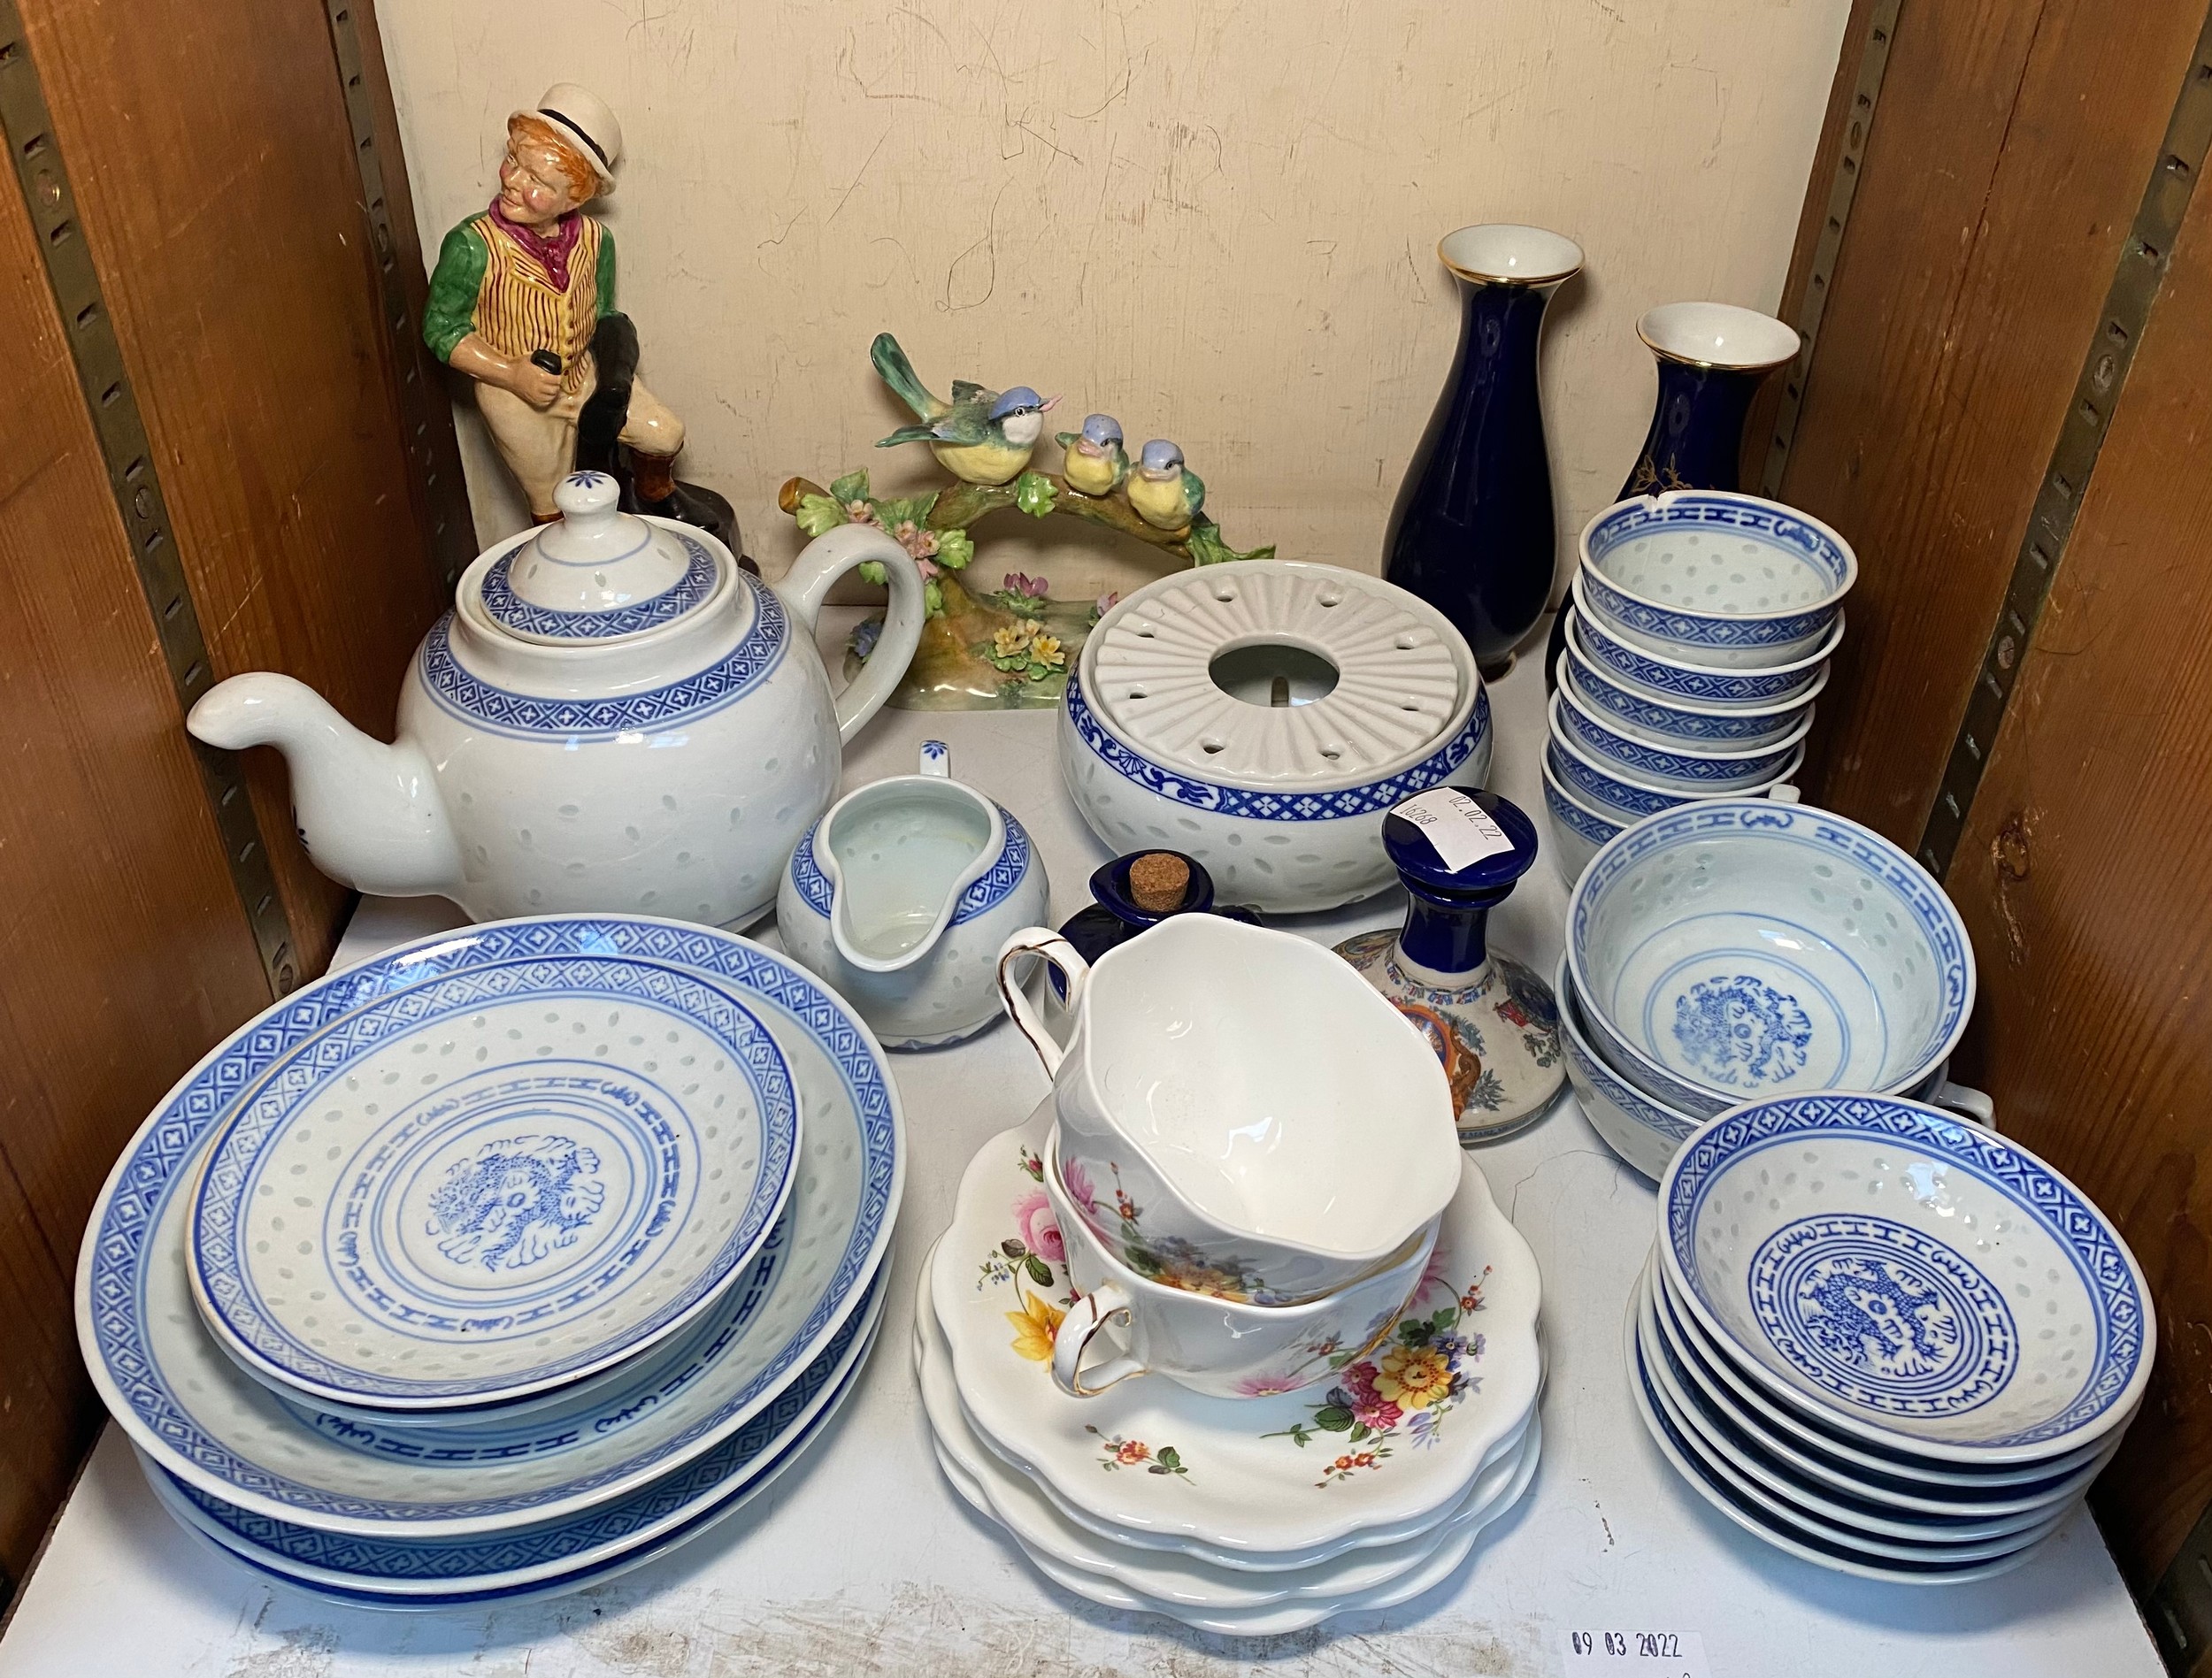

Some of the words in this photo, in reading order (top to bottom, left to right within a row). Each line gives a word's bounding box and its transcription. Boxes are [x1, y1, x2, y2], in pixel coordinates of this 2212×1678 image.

[1448, 795, 1502, 840] 02.02.22
[1571, 1631, 1593, 1656] 09
[1604, 1631, 1627, 1656] 03
[1635, 1632, 1683, 1658] 2022
